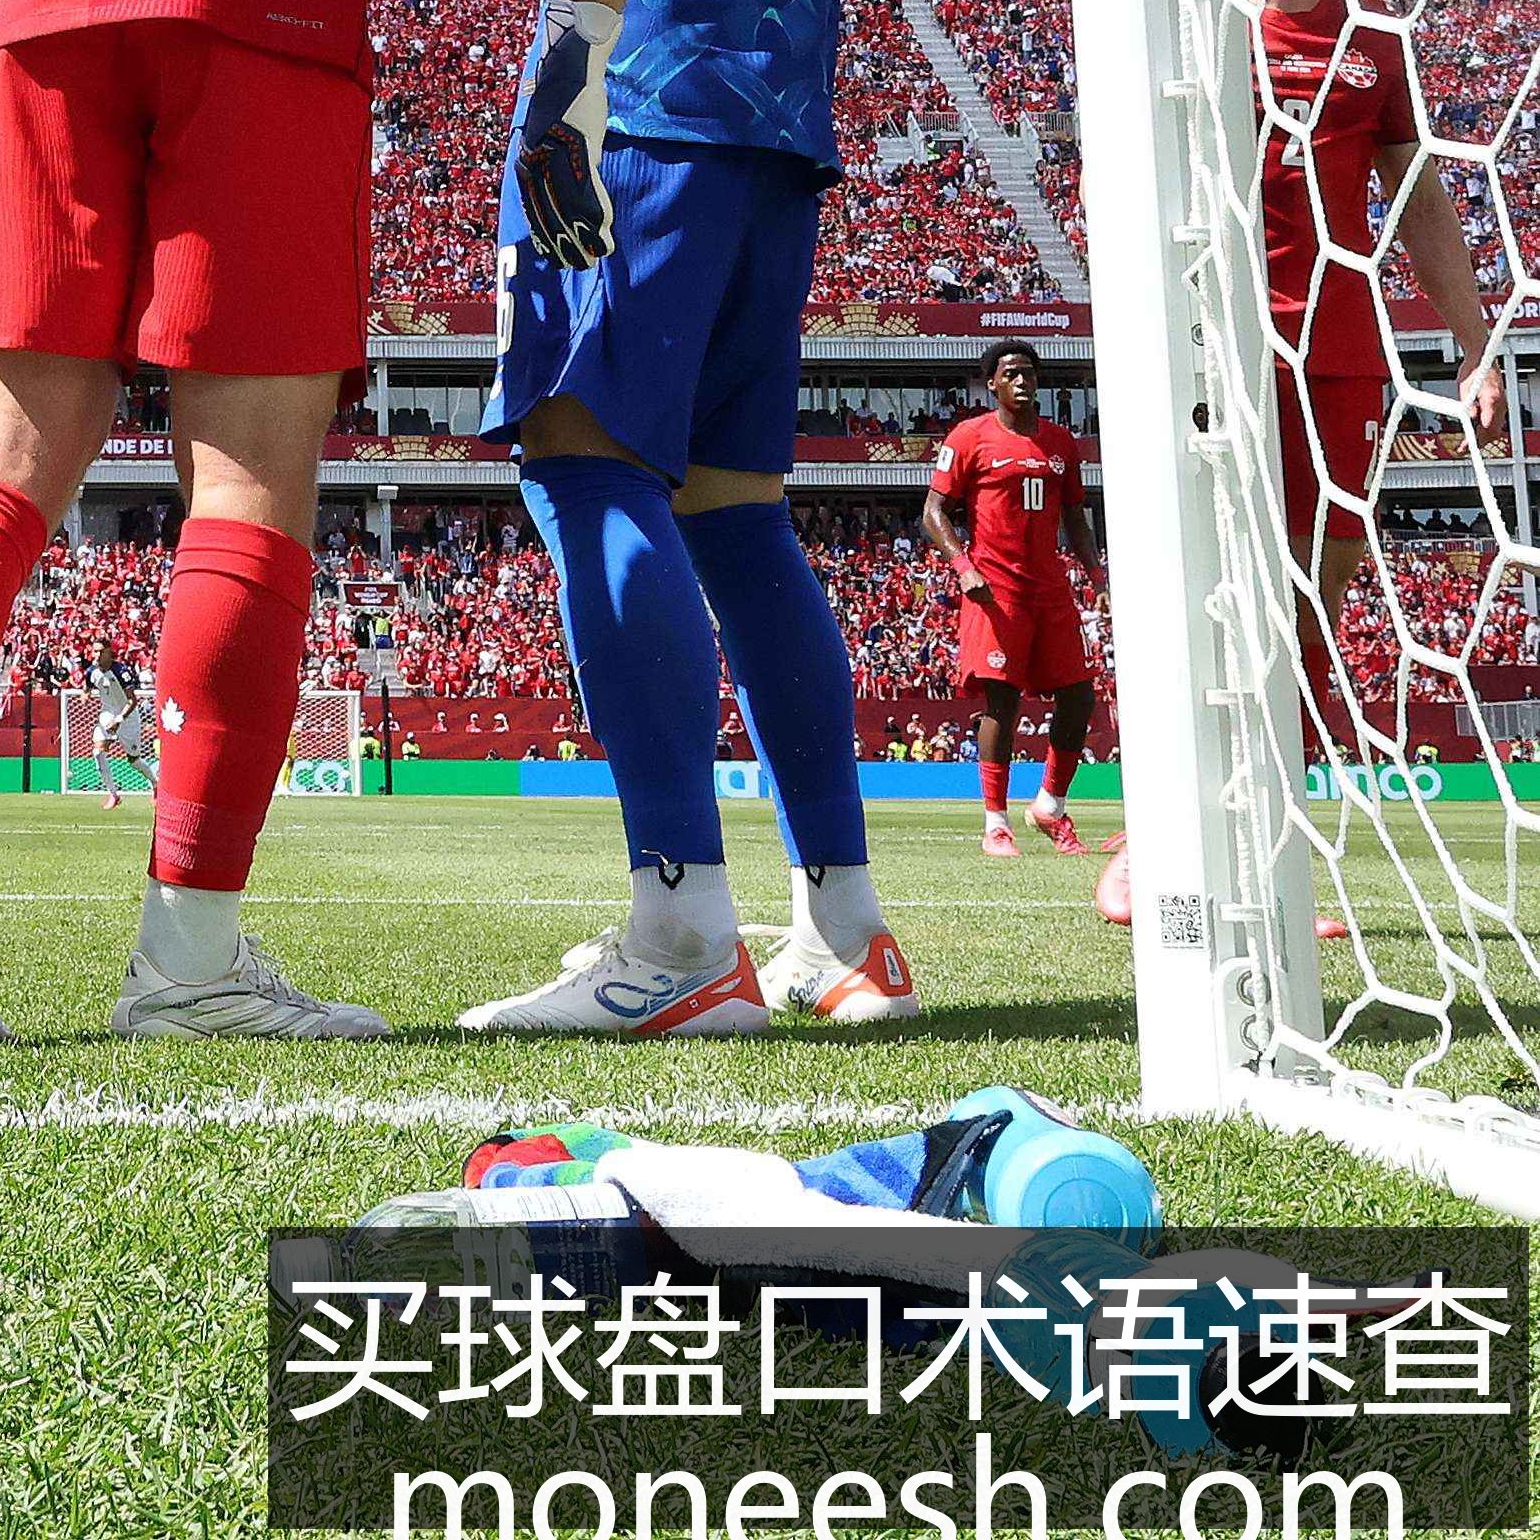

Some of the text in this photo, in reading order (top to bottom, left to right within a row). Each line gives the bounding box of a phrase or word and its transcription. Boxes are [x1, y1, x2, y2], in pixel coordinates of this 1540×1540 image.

[980, 312, 1070, 329] #FIFAWorldCup
[101, 439, 137, 454] NDE
[140, 439, 165, 454] DE
[1022, 477, 1044, 511] 10
[1306, 765, 1443, 800] amco
